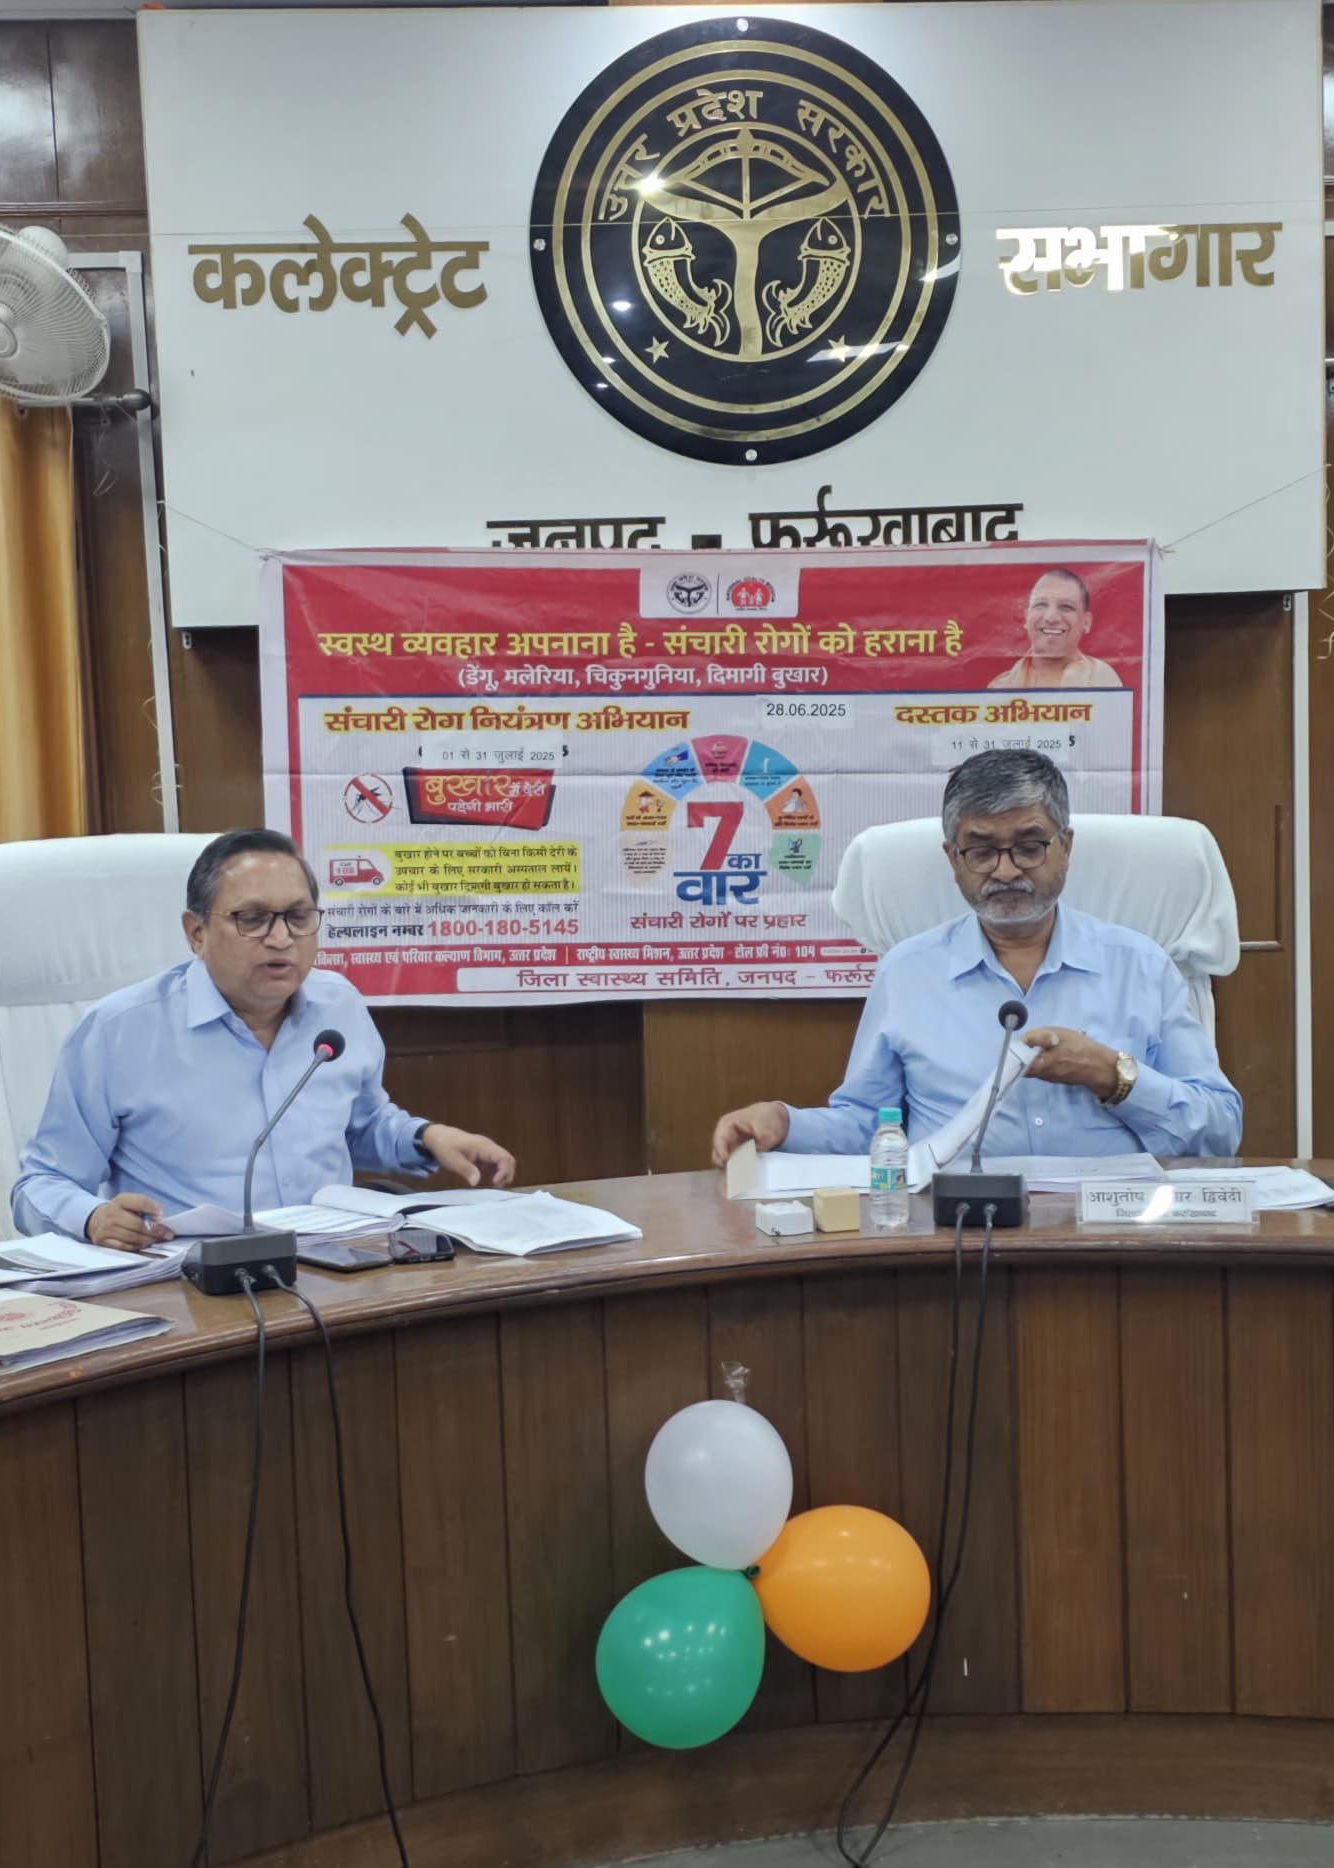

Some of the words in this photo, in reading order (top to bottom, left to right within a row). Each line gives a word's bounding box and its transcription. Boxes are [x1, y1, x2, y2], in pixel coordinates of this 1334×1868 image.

[667, 88, 764, 138] प्रदेश
[797, 99, 892, 220] सरकार
[996, 222, 1283, 296] सभागार
[188, 212, 490, 341] कलेक्ट्रेट
[317, 632, 394, 656] स्वस्थ
[401, 632, 499, 659] व्यवहार
[507, 632, 610, 655] अपनाना
[617, 622, 637, 659] है
[663, 624, 747, 655] संचारी
[755, 622, 812, 655] रोगों
[817, 622, 856, 655] को
[864, 629, 937, 657] हराना
[944, 620, 963, 657] है
[505, 664, 580, 688] मलेरिया,
[585, 663, 702, 690] चिकुनगुनिया,
[706, 662, 766, 684] दिमागी
[771, 664, 828, 689] बुखार)
[323, 705, 407, 732] संचारी
[412, 705, 466, 732] रोग
[469, 705, 571, 732] नियंत्रण
[576, 704, 691, 731] अभियान
[766, 703, 846, 718] 28.06.2025
[894, 705, 979, 724] दस्तक
[983, 698, 1093, 724] अभियान
[443, 752, 454, 761] 01
[476, 752, 487, 761] 31
[494, 747, 524, 764] जुलाई
[530, 752, 555, 761] 2025
[952, 741, 963, 750] 11
[983, 740, 996, 750] 31
[1002, 736, 1032, 750] जलाई
[1037, 739, 1062, 749] 2025
[425, 774, 513, 805] बुखार
[687, 801, 744, 870] 7
[726, 853, 762, 870] का
[673, 871, 768, 906] वार
[327, 924, 388, 938] हेल्पलाइन
[392, 924, 424, 936] नम्बर
[428, 919, 578, 936] 1800-180-5145
[630, 912, 685, 931] संचारी
[690, 911, 732, 929] रोगों
[734, 915, 758, 929] पर
[762, 914, 808, 929] प्रहार
[796, 945, 815, 958] 104
[516, 969, 570, 988] जिला
[576, 972, 649, 986] स्वास्थ्य
[738, 970, 797, 985] जनपद
